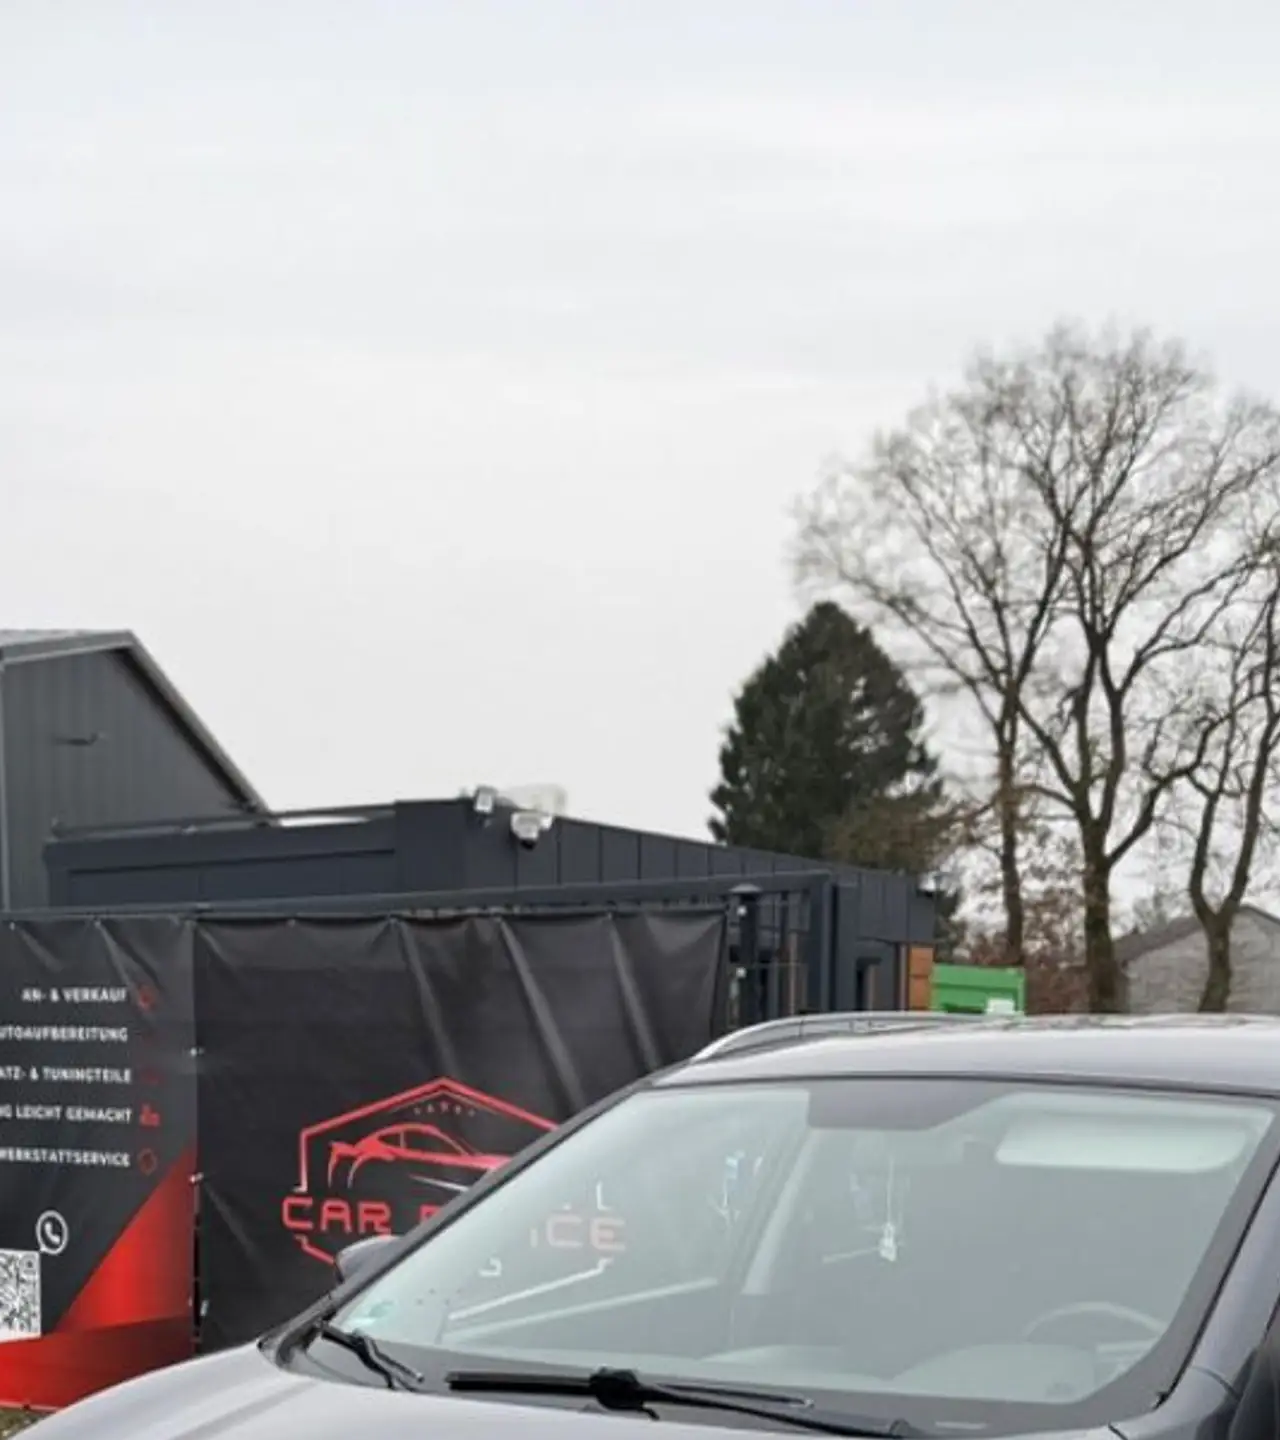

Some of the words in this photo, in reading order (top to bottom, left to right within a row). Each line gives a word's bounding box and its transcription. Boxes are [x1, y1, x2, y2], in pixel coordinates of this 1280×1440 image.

[62, 986, 127, 1003] VERKAUF
[42, 1066, 132, 1084] TUNINGTEILE
[16, 1104, 63, 1120] LEICHT
[66, 1106, 133, 1123] GEMACHT
[281, 1196, 392, 1234] CAR
